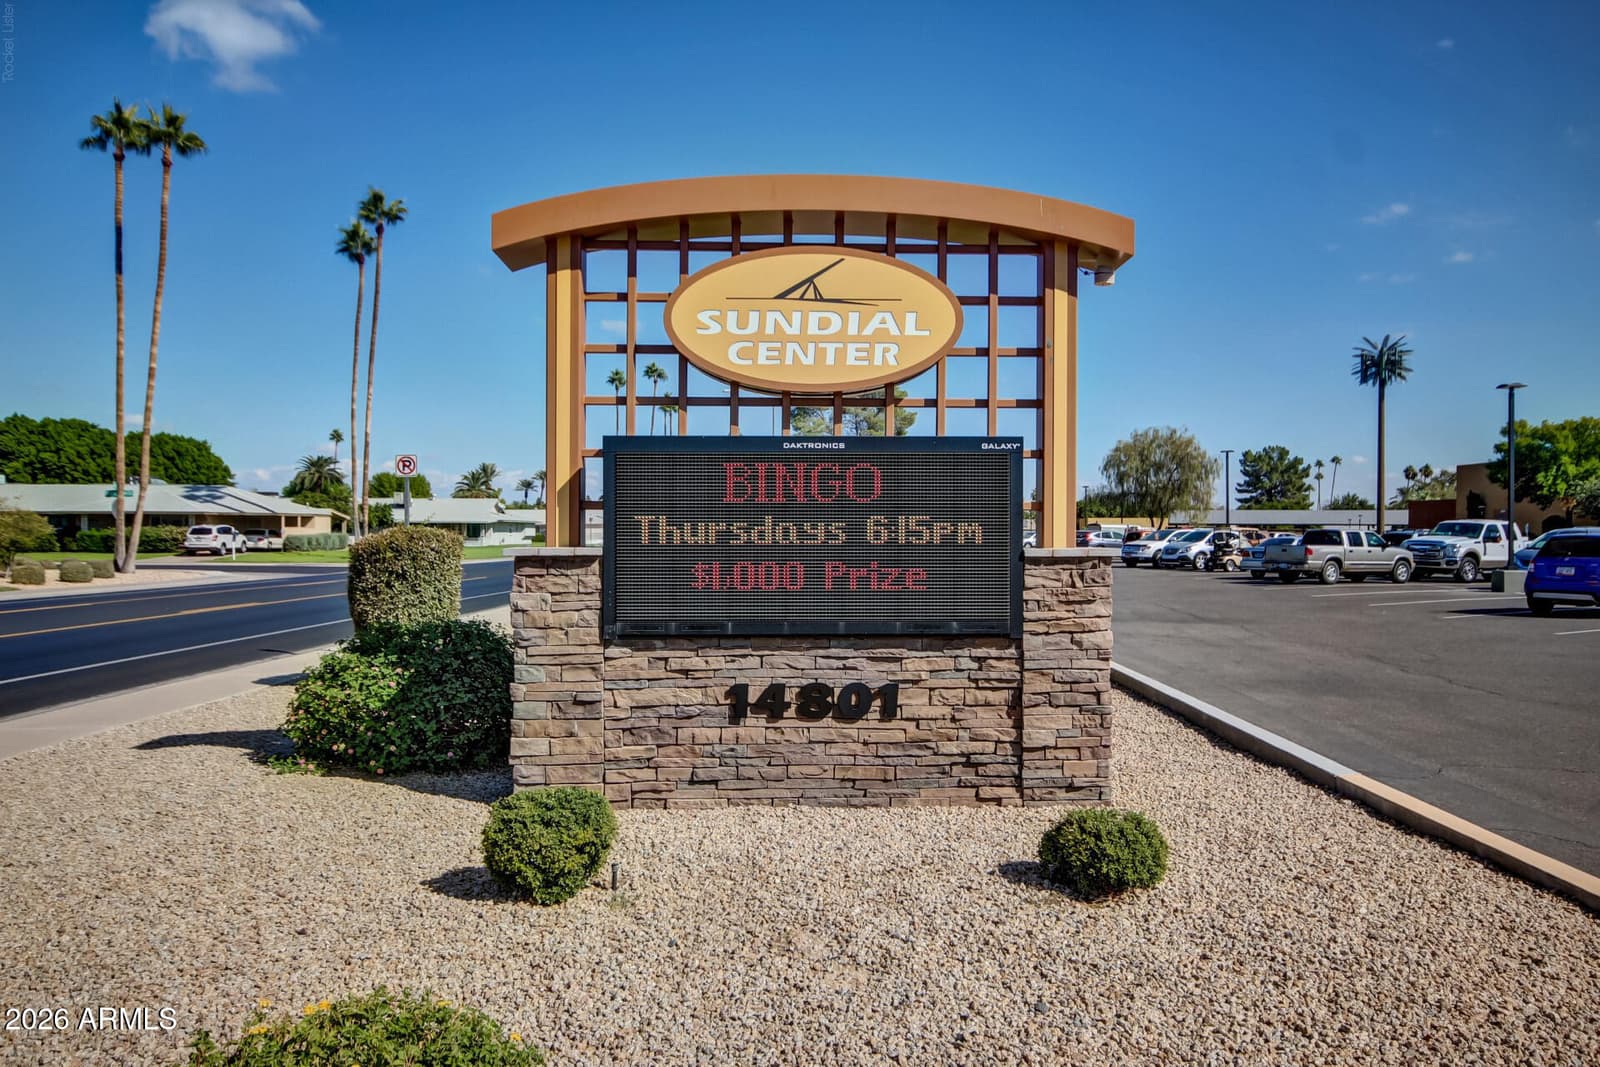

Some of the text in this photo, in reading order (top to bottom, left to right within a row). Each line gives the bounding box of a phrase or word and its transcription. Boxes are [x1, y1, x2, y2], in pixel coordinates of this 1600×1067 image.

[696, 309, 931, 337] SUNDIAL
[727, 340, 900, 367] CENTER
[722, 462, 883, 503] BINGO
[633, 515, 983, 545] Thursdays 6:15pm
[691, 560, 928, 591] $1,000 Prize
[724, 682, 900, 724] 14801
